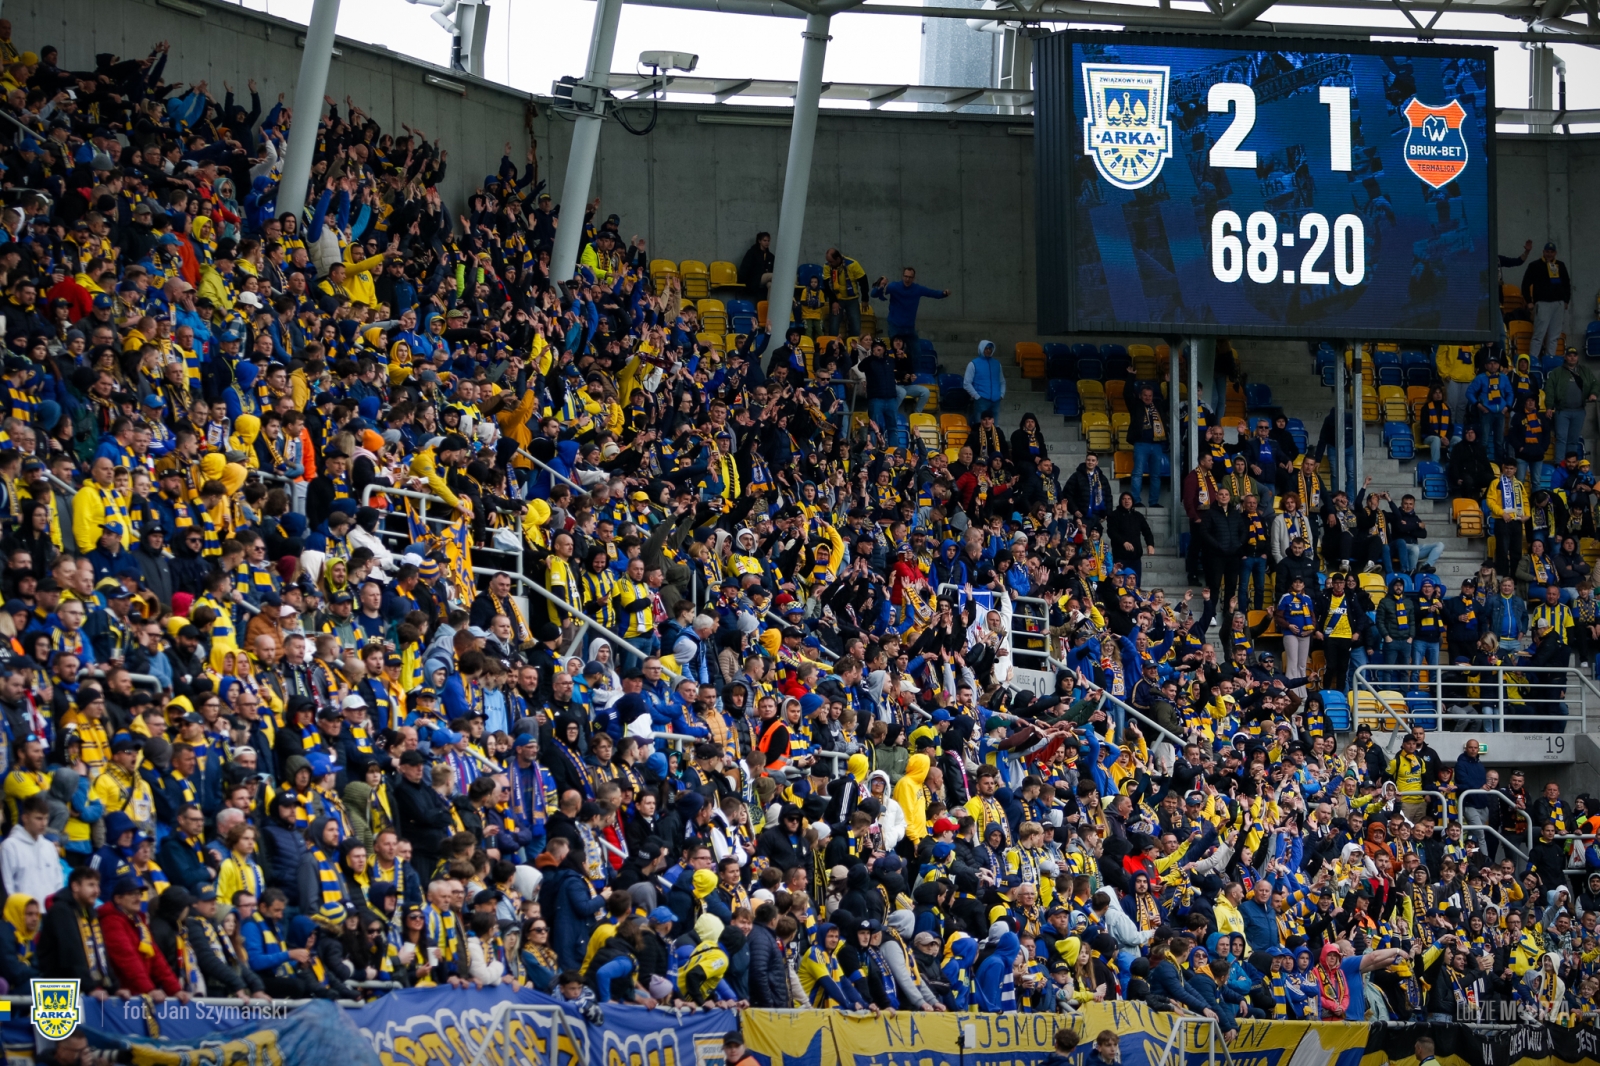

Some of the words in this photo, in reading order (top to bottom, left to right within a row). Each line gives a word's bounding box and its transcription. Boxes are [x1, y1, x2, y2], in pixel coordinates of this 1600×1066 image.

[1100, 131, 1156, 145] ARKA
[1207, 82, 1258, 168] 2
[1319, 86, 1352, 171] 1
[1409, 145, 1461, 157] BRUK-BET
[1103, 149, 1155, 177] GDYNIA
[1417, 163, 1456, 172] TERMALICA
[1211, 210, 1365, 286] 68:20
[1545, 736, 1565, 754] 19
[883, 1014, 925, 1047] NA
